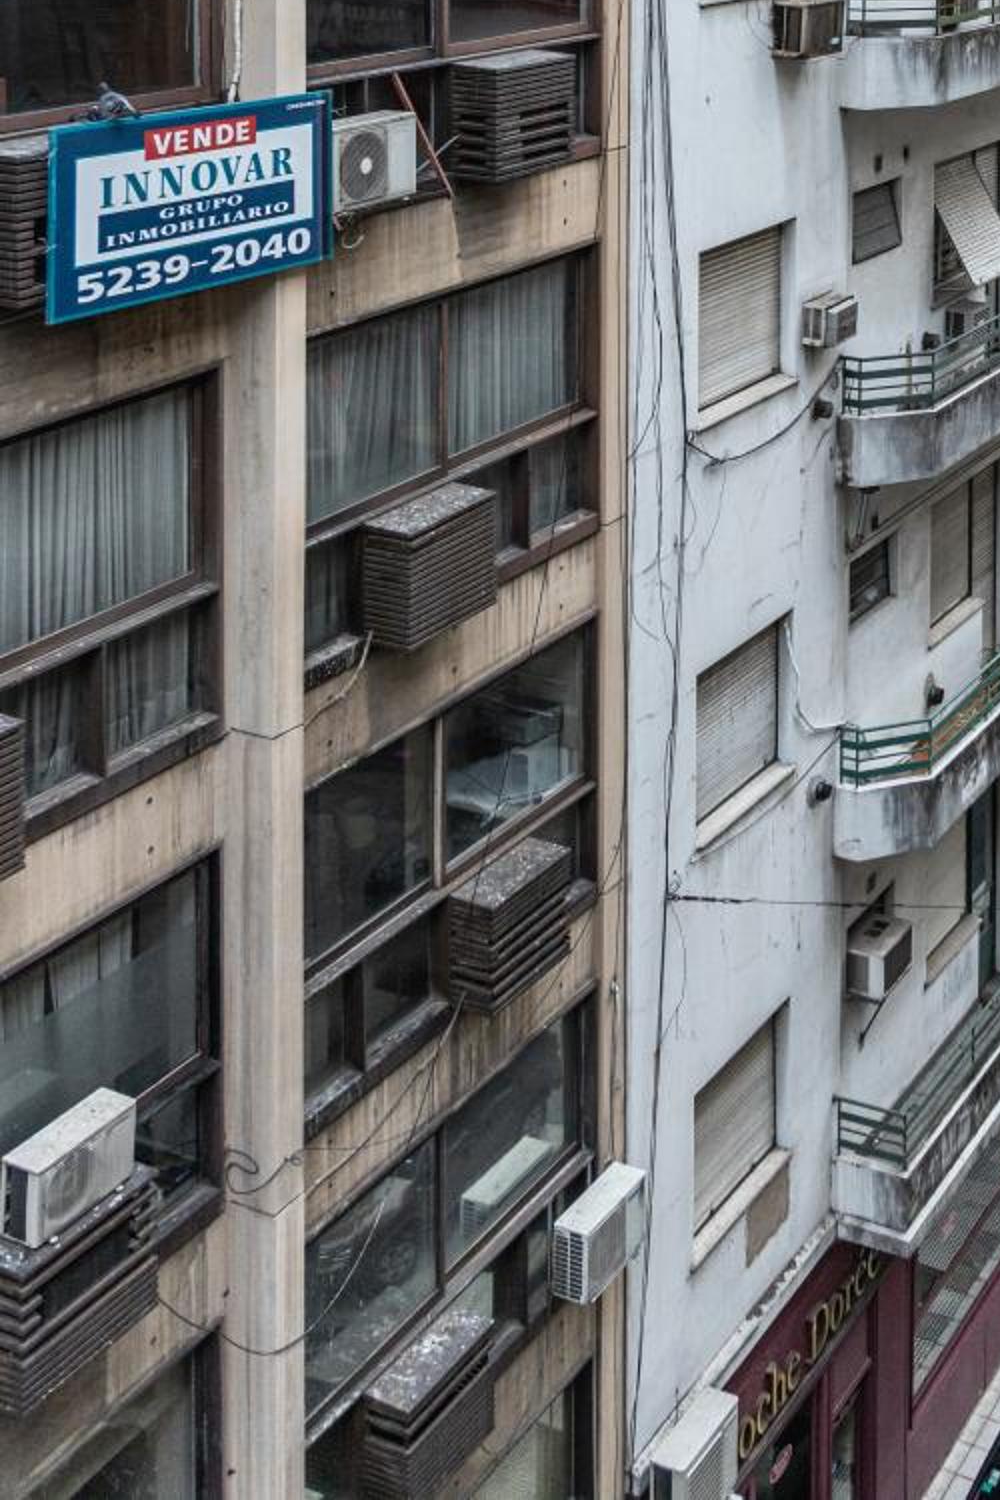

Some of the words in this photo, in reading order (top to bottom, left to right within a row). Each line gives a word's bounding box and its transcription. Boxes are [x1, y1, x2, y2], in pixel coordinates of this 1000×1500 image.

[153, 119, 251, 156] VENDE
[101, 147, 293, 209] INNOVAR
[106, 201, 289, 248] INMOBILIARIO
[159, 193, 243, 220] GRUPO
[77, 227, 311, 304] 5239-2040
[740, 1350, 800, 1459] oche
